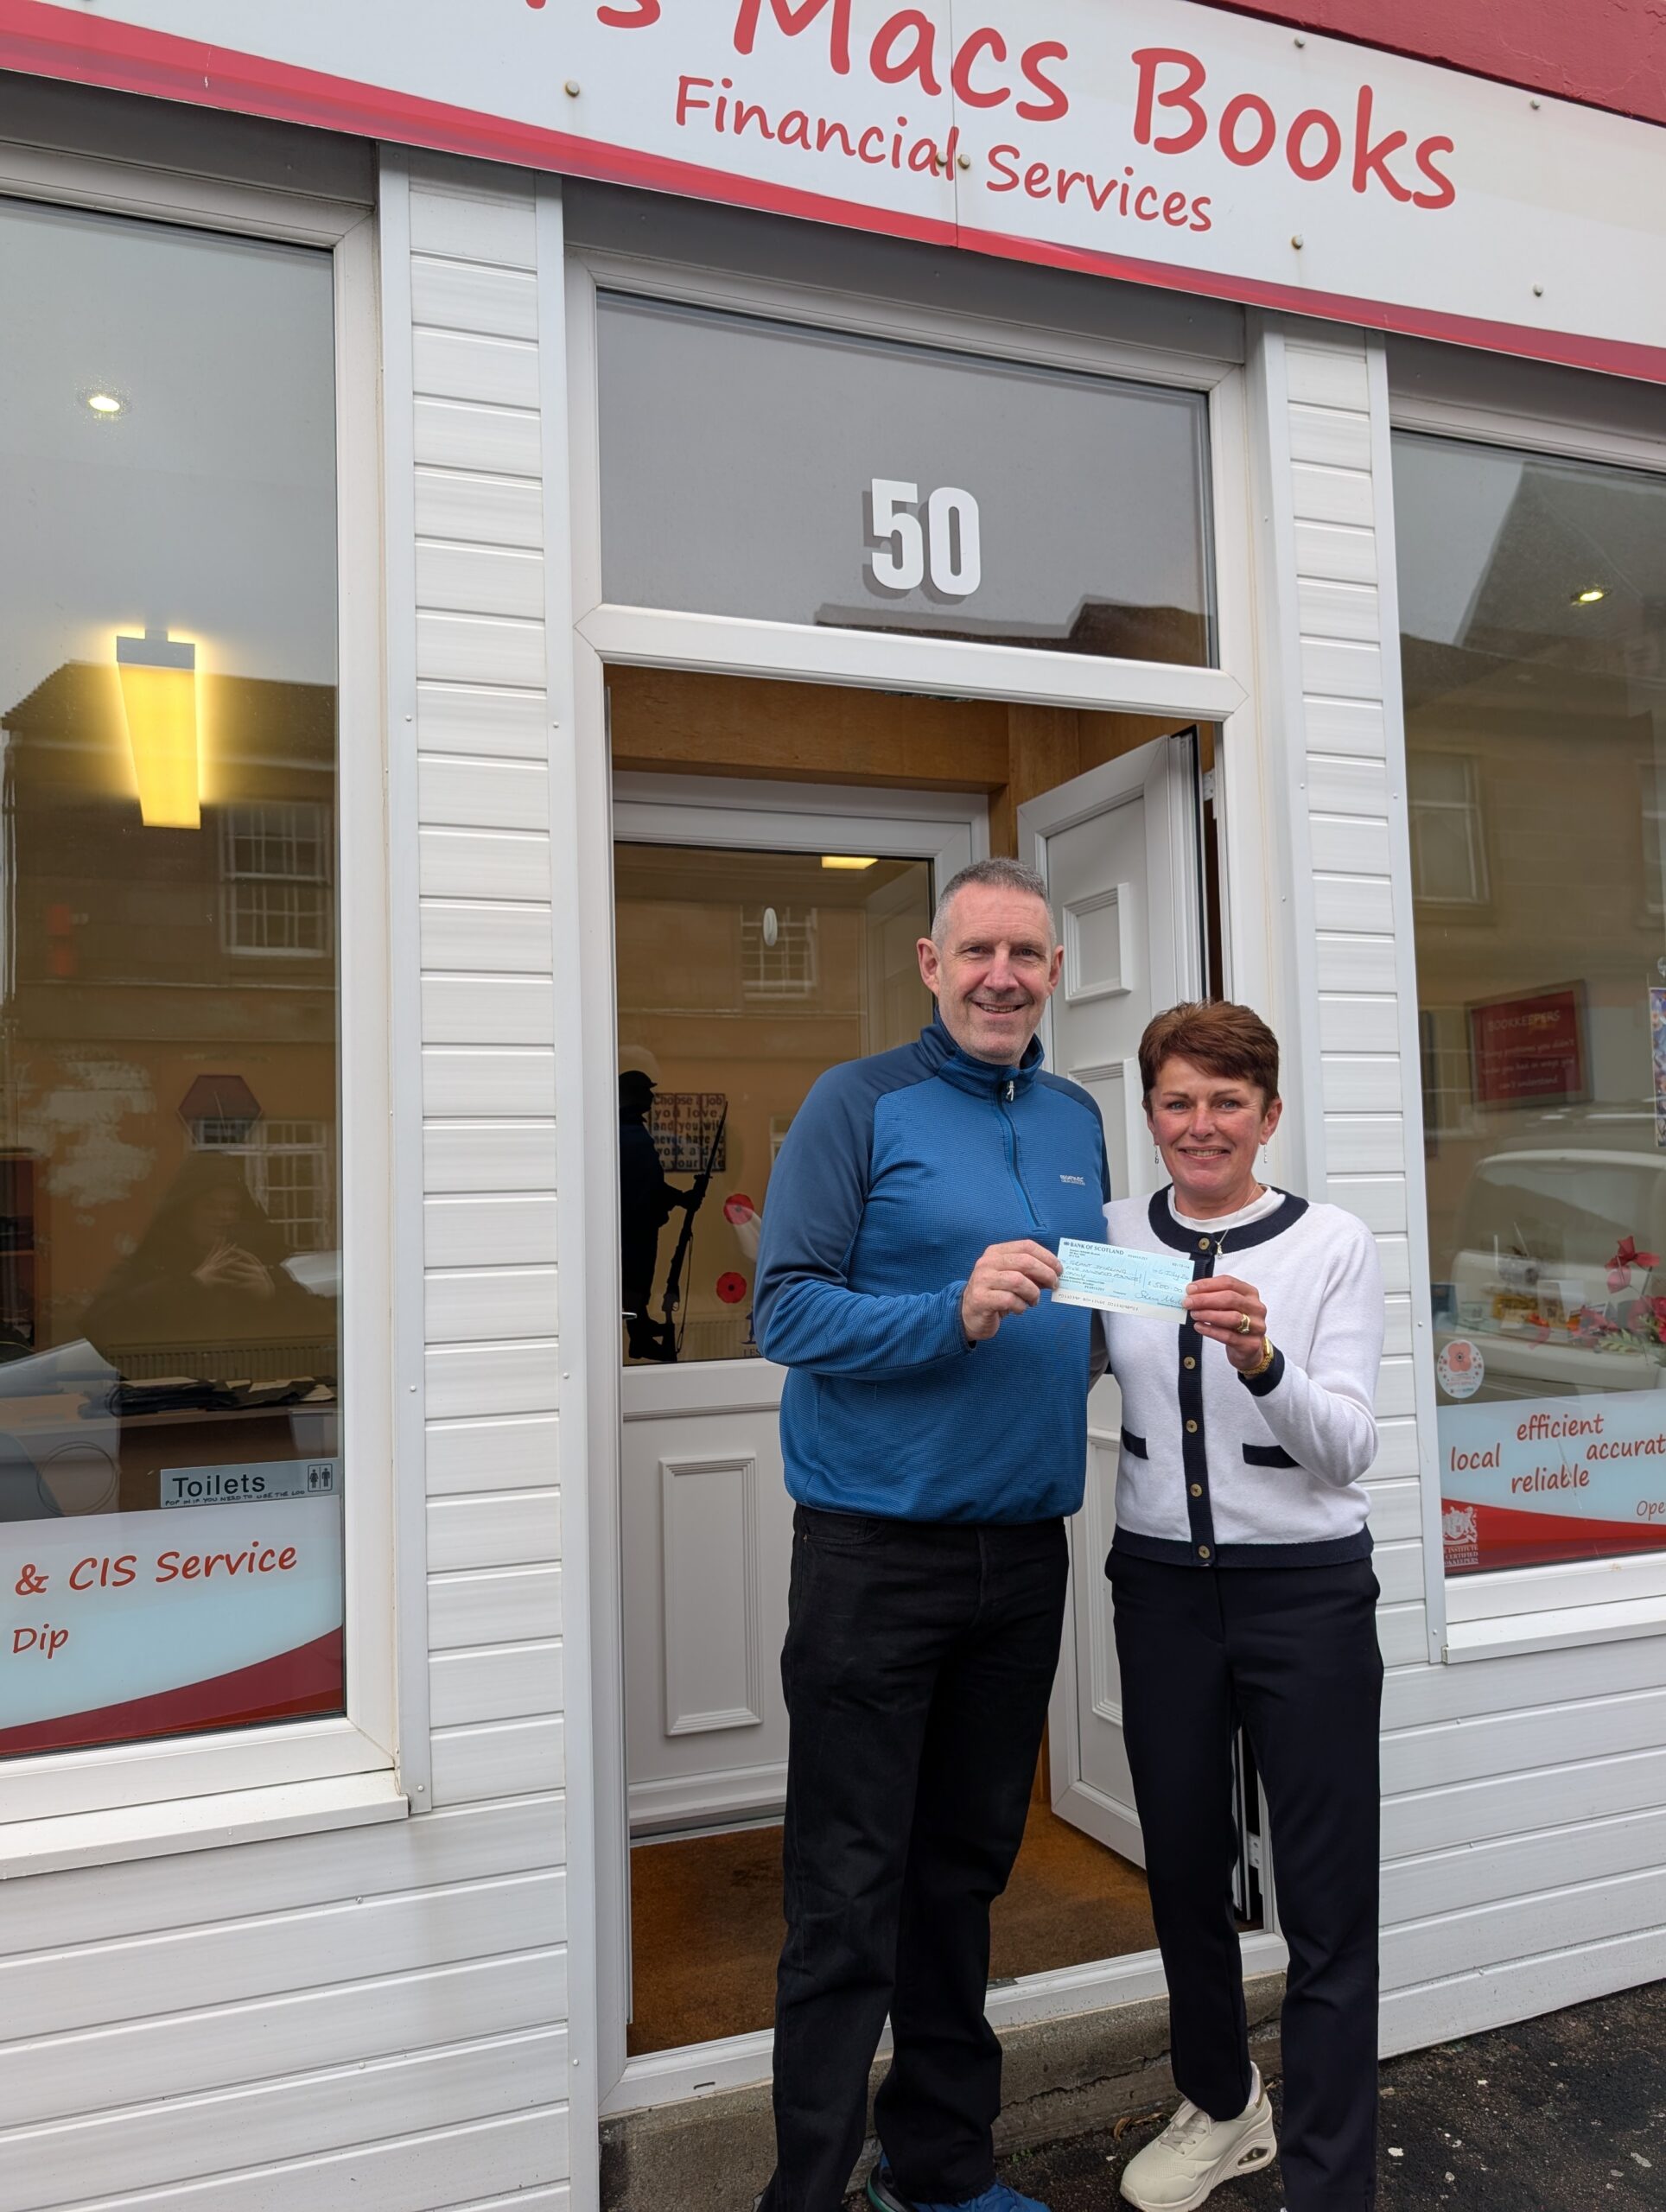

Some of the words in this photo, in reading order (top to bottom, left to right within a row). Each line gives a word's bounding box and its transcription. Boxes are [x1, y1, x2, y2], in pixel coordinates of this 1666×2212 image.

[734, 0, 1069, 121] Macs
[1132, 48, 1456, 208] Books
[676, 75, 959, 181] Financial
[987, 145, 1211, 232] Services
[872, 478, 982, 595] 50
[1487, 1009, 1561, 1032] BOOKKEEPERS
[654, 1096, 692, 1105] Choose
[707, 1096, 722, 1107] job
[655, 1109, 680, 1120] you
[653, 1121, 674, 1130] and
[677, 1122, 698, 1133] you
[654, 1135, 683, 1144] never
[701, 1146, 723, 1158] dy
[671, 1160, 698, 1169] your
[1094, 1246, 1124, 1255] SCOTLAND
[1517, 1414, 1605, 1441] efficient
[1451, 1443, 1501, 1471] local
[1587, 1433, 1666, 1461] accurat
[172, 1474, 265, 1498] Toilets
[1511, 1463, 1590, 1494] reliable
[1637, 1500, 1666, 1522] Ope
[1445, 1551, 1478, 1560] CERTIFIED
[1448, 1545, 1478, 1554] INSTITUTE
[15, 1564, 49, 1596] &
[69, 1555, 137, 1591] CIS
[156, 1541, 297, 1583] Service
[13, 1624, 69, 1659] Dip
